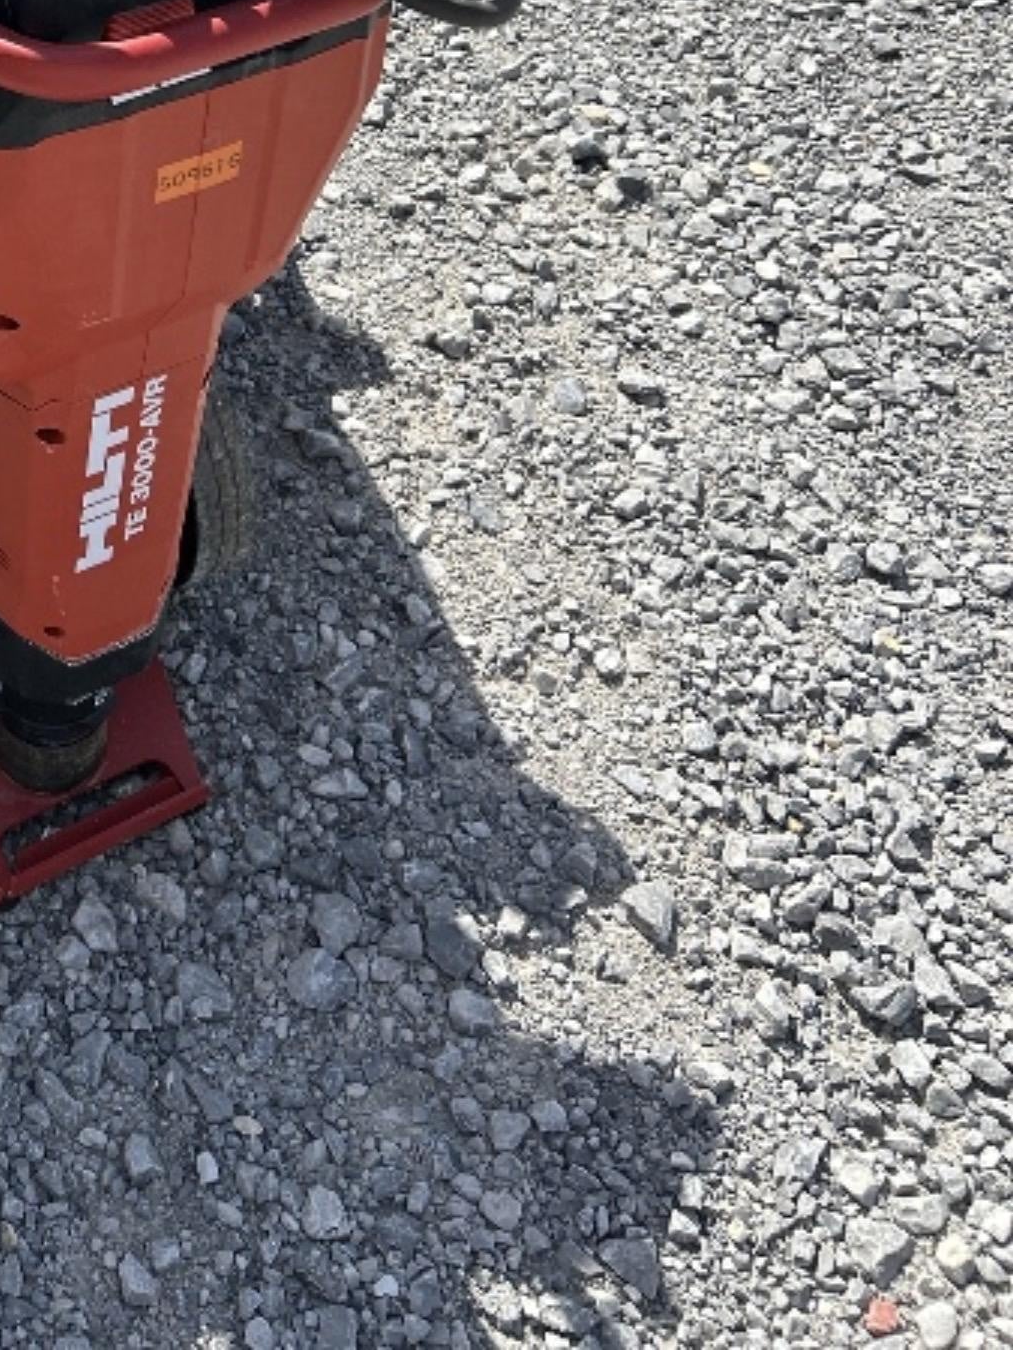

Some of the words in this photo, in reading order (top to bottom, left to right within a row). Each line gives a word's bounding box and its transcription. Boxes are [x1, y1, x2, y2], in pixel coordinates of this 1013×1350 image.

[73, 385, 136, 574] HILTI
[130, 373, 168, 505] 3000-AVR
[123, 505, 147, 542] TE
